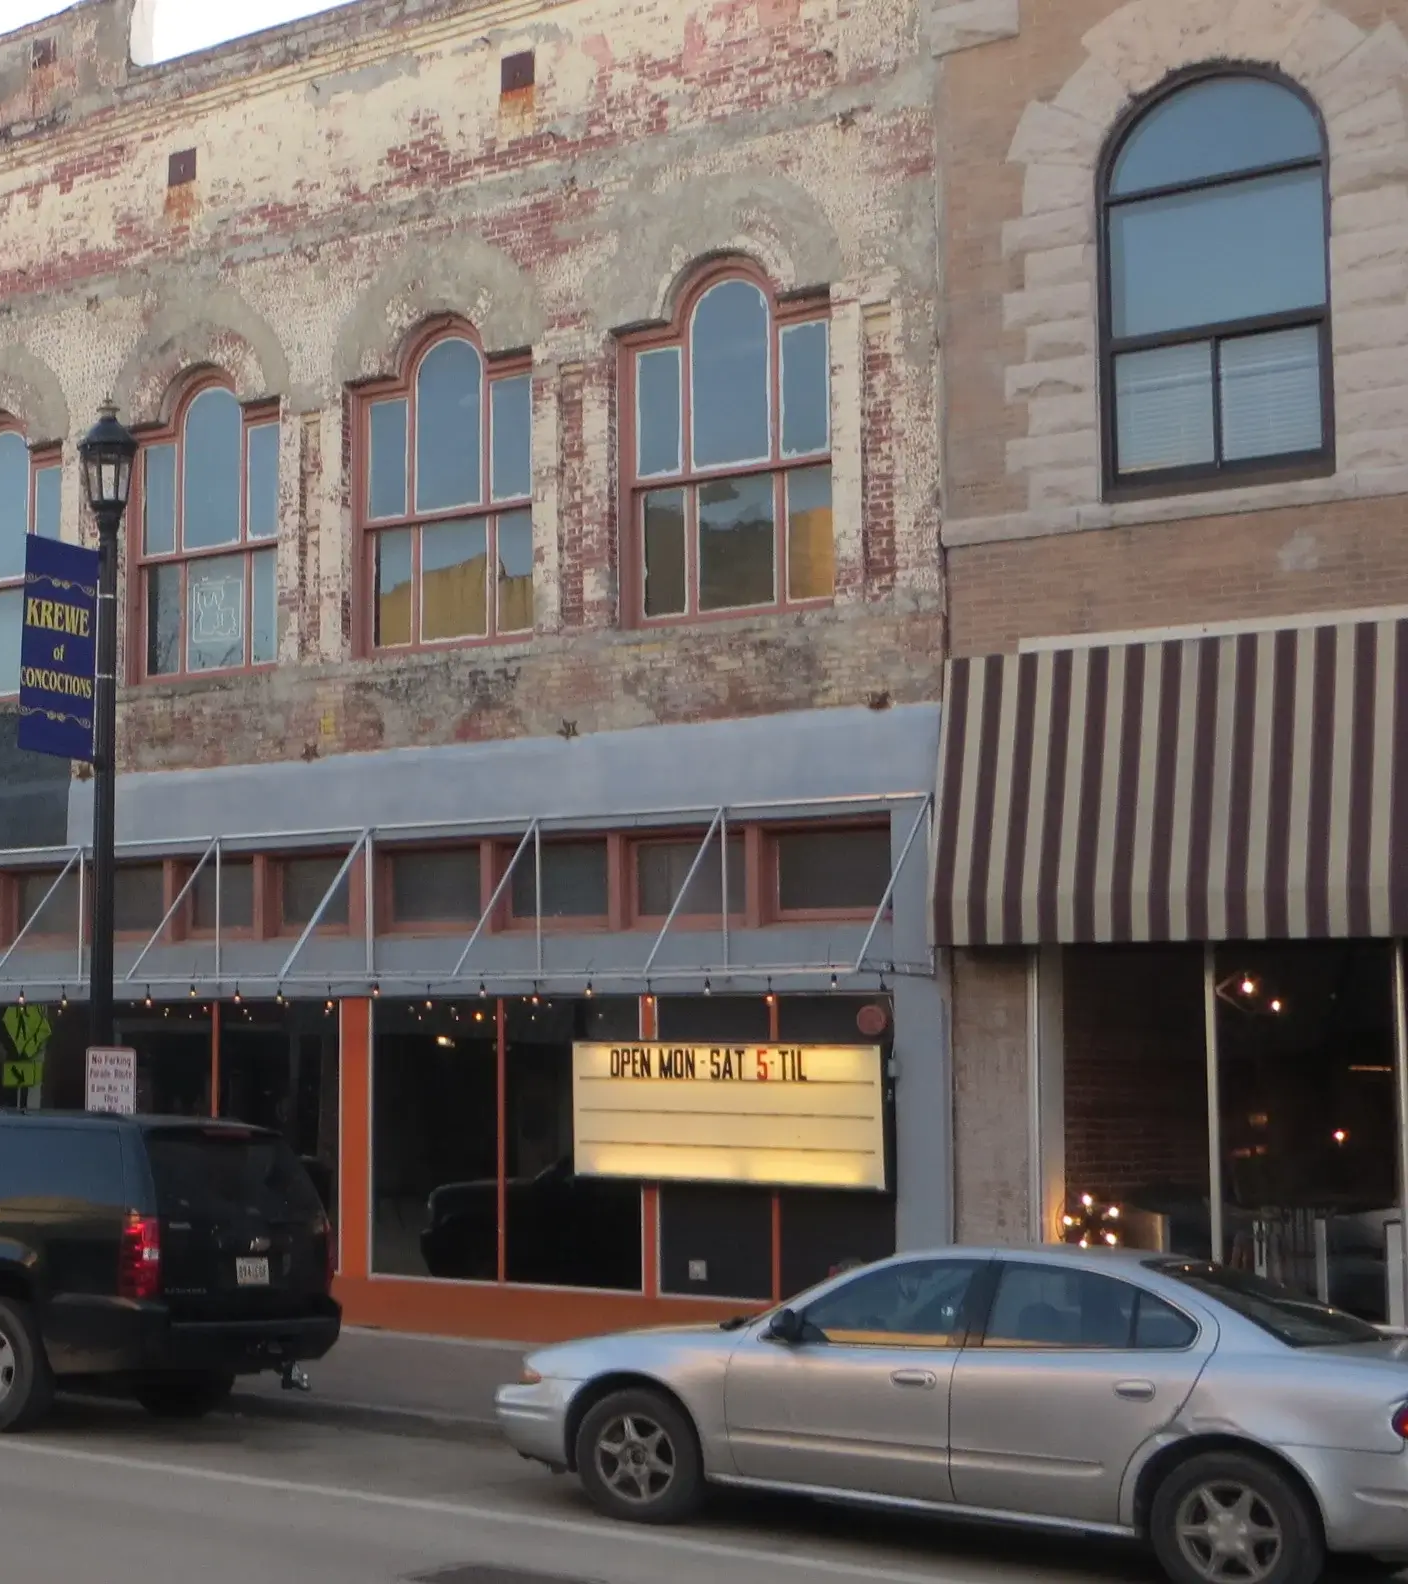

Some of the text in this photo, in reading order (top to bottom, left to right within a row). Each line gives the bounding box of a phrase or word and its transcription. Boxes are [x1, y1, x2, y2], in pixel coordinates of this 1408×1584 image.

[26, 597, 90, 637] KREWE
[53, 644, 65, 661] of
[20, 666, 92, 699] CONCOCTIONS
[610, 1048, 651, 1078] OPEN
